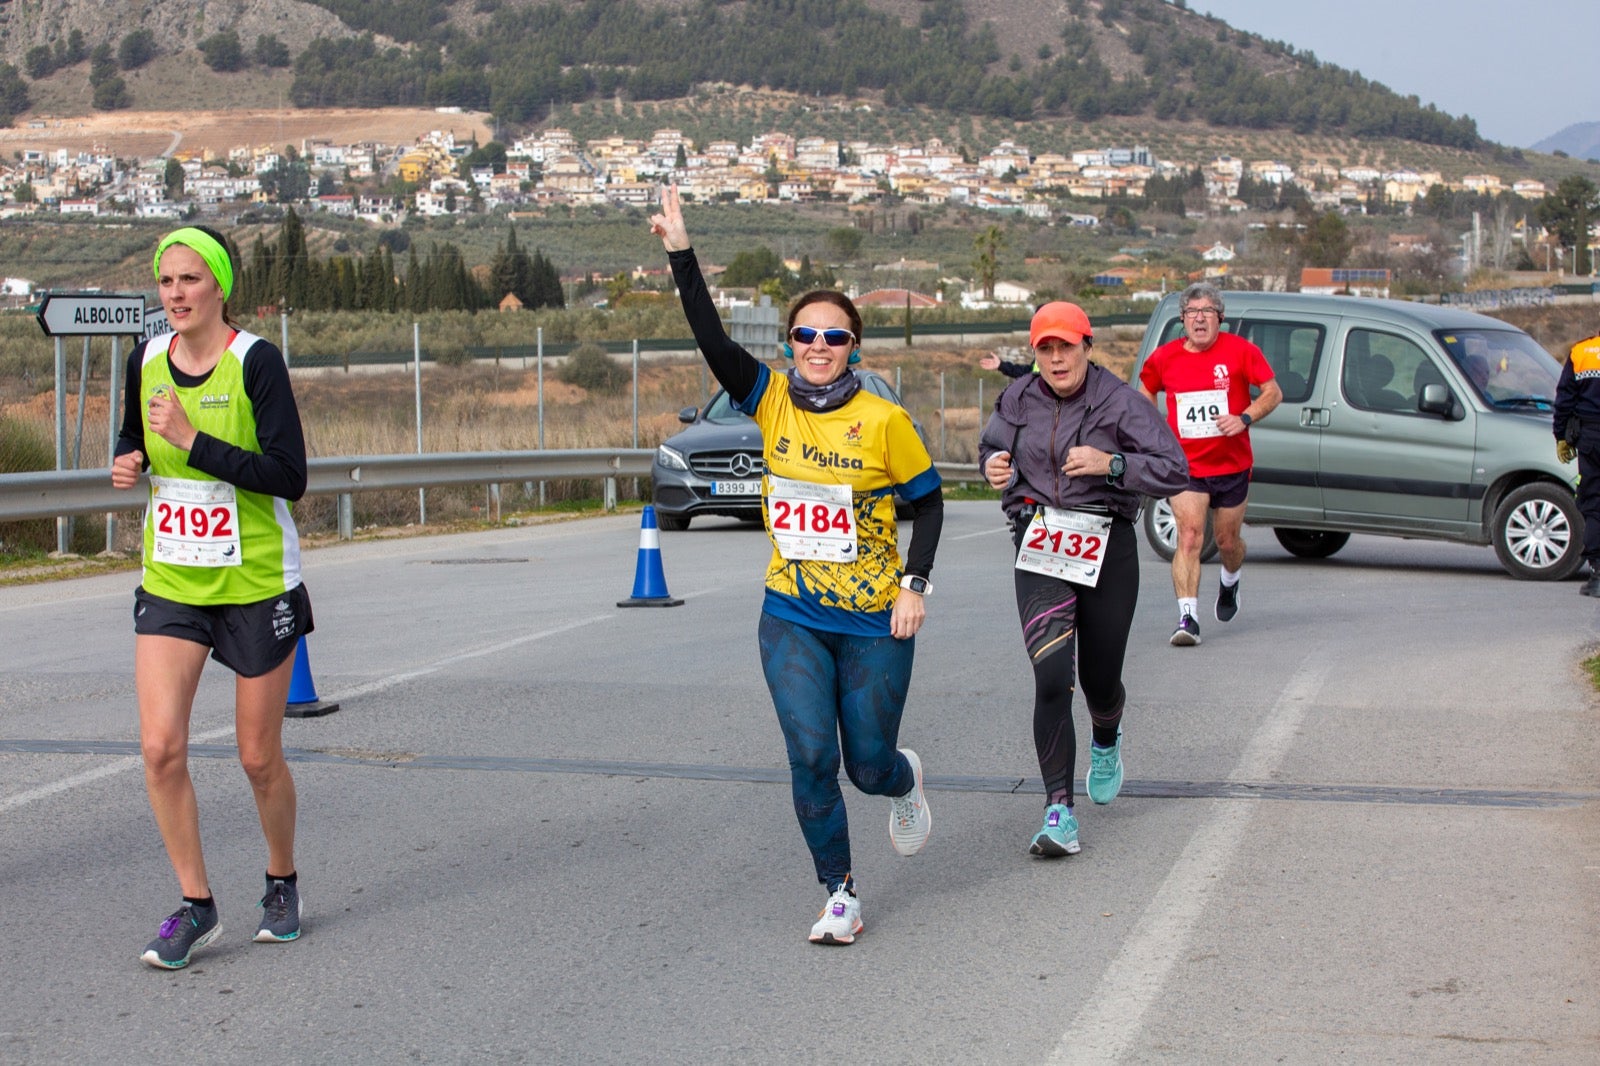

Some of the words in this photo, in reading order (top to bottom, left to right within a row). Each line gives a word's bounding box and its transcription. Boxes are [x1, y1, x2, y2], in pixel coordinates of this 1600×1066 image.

[74, 306, 140, 324] ALBOLOTE
[1186, 404, 1220, 423] 419
[802, 443, 864, 470] Vigilsa
[718, 482, 745, 493] 8399
[158, 502, 232, 538] 2192
[773, 501, 851, 535] 2184
[1026, 527, 1101, 561] 2132
